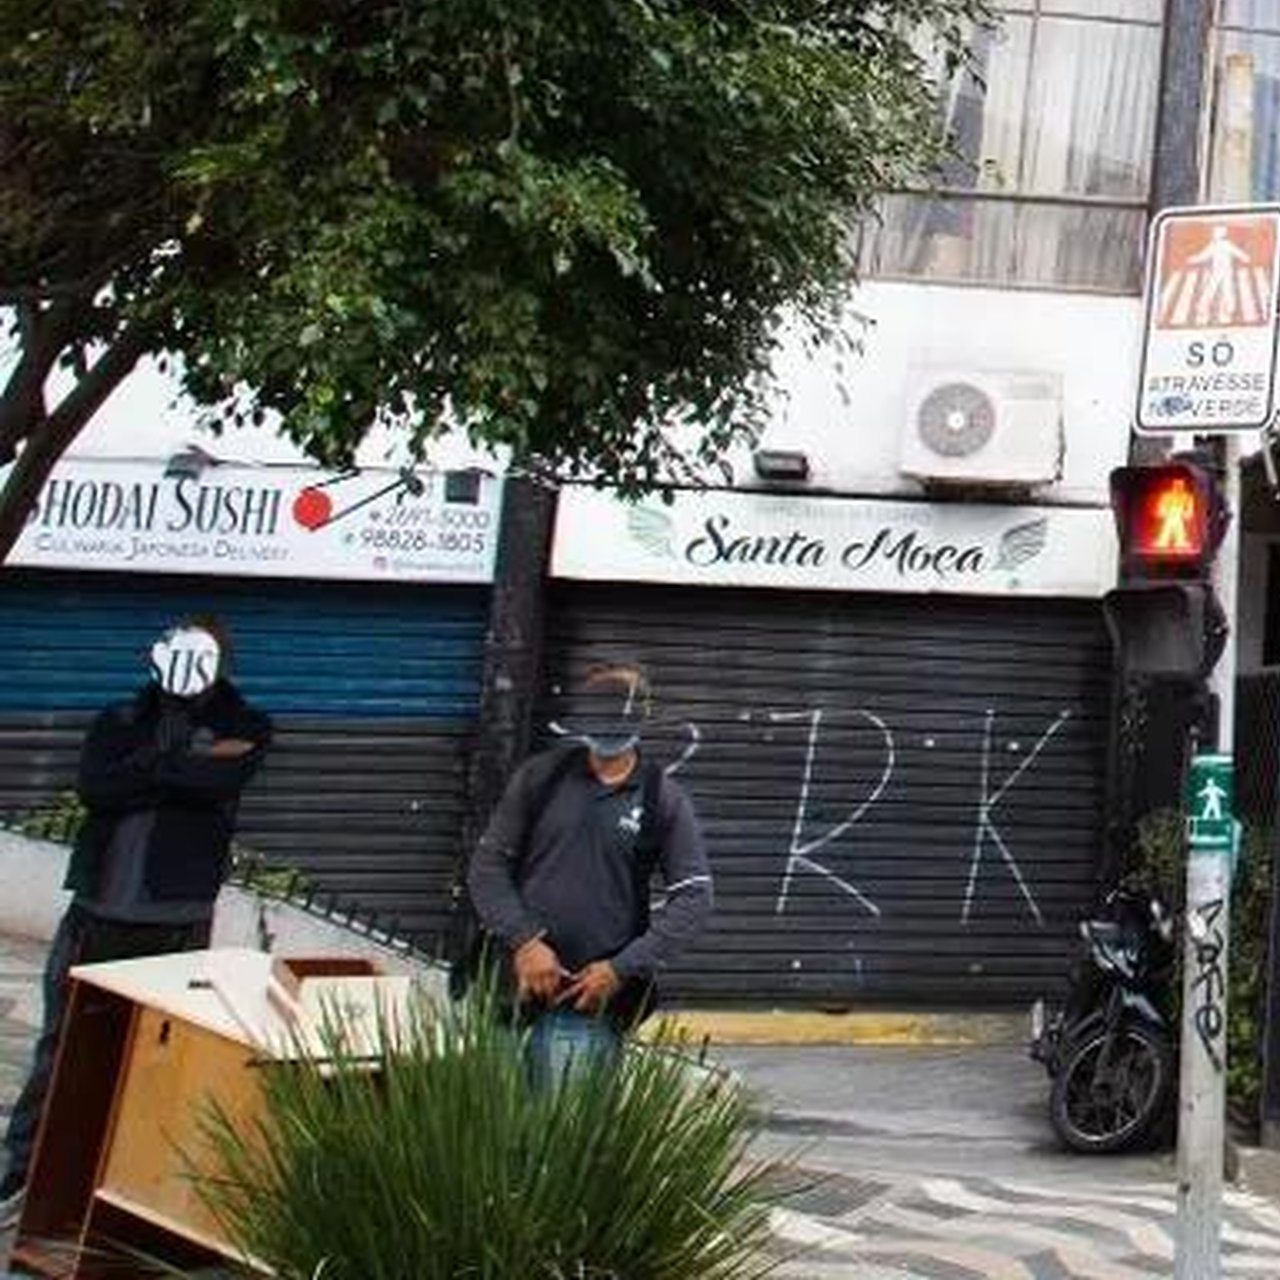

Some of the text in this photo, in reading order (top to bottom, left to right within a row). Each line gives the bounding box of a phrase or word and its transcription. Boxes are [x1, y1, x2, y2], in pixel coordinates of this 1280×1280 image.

[1148, 373, 1265, 392] ATRAVESSE
[1192, 398, 1263, 418] VERDE
[30, 475, 282, 535] HODAI SUSHI
[685, 516, 826, 568] Santa
